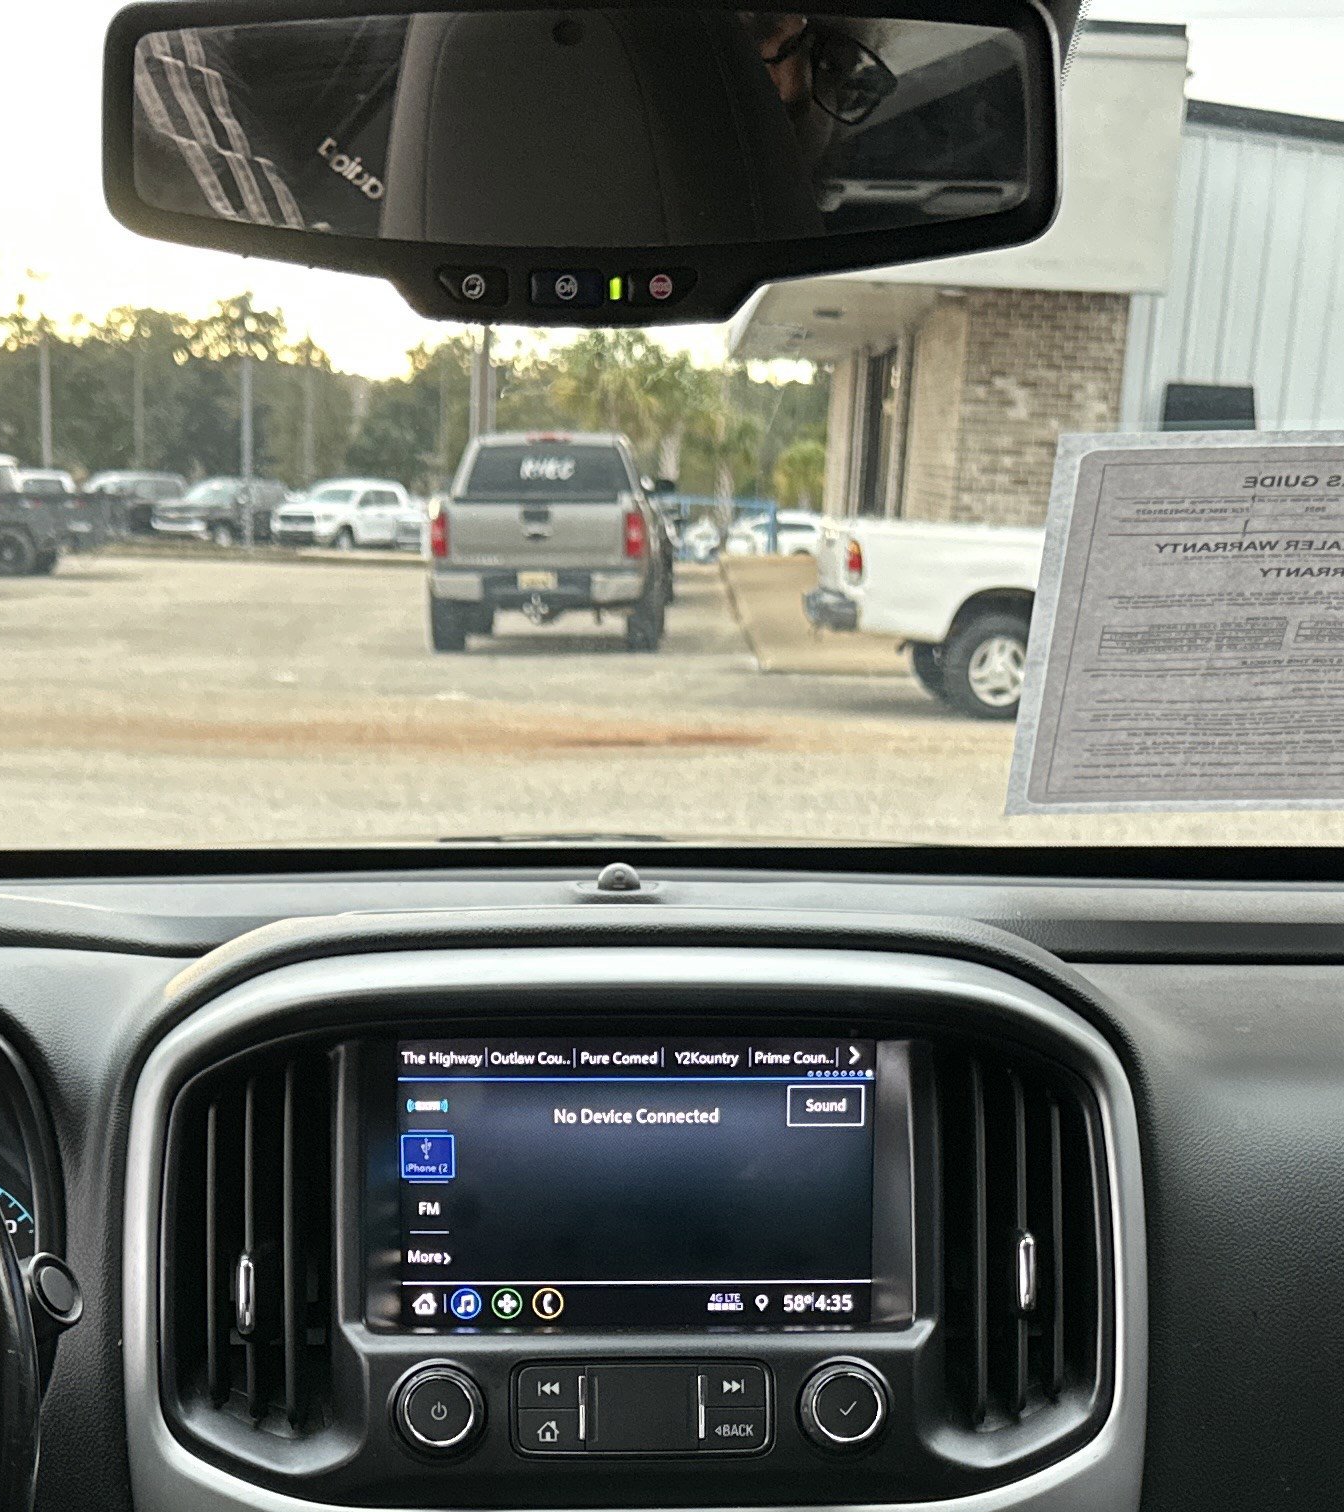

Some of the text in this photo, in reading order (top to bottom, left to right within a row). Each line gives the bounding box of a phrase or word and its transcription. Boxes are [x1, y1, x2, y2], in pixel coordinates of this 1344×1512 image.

[401, 1051, 483, 1067] The Highway
[490, 1051, 572, 1065] Outlaw Cou..
[580, 1051, 658, 1065] Pure Comed
[674, 1051, 739, 1068] Y2Kountry
[754, 1051, 835, 1065] Prime Coun..
[805, 1098, 847, 1113] Sound
[554, 1108, 720, 1124] No Device Connected
[418, 1201, 441, 1216] FM
[407, 1249, 443, 1265] More
[709, 1293, 741, 1303] 4G LTE
[814, 1293, 854, 1312] 4:35
[723, 1424, 755, 1438] BACK
